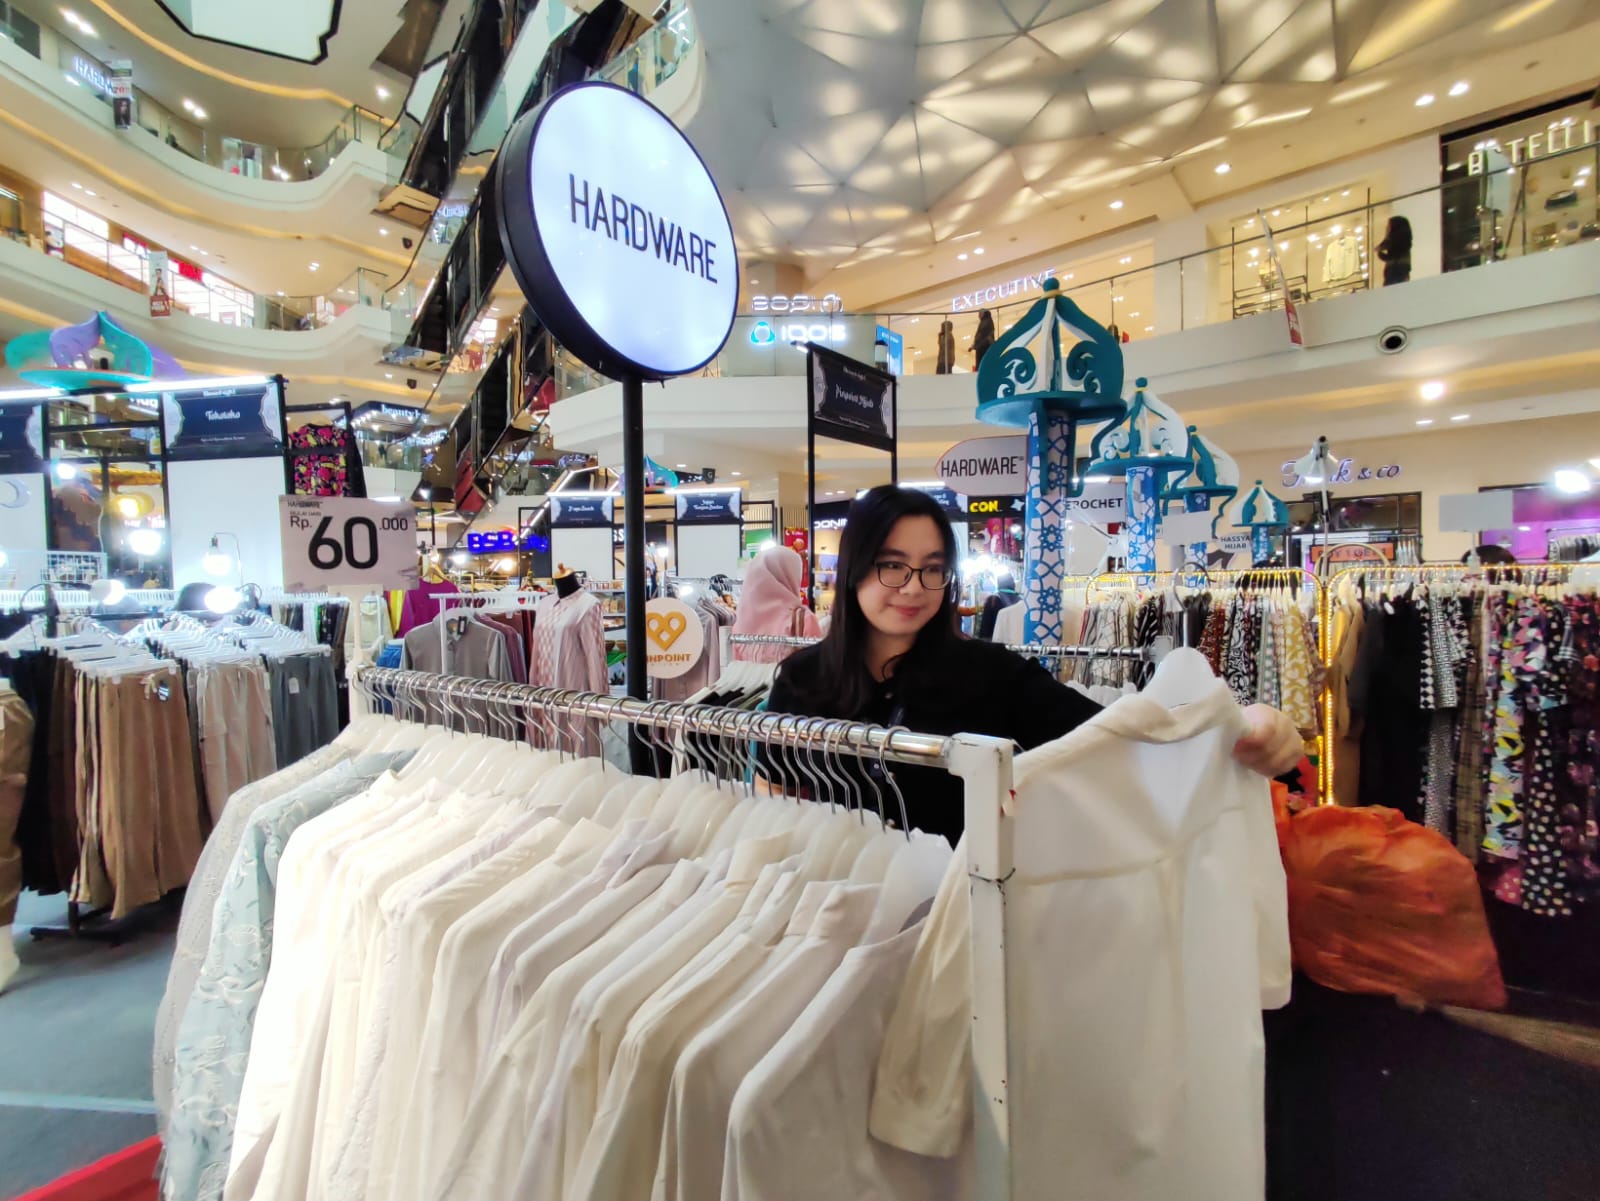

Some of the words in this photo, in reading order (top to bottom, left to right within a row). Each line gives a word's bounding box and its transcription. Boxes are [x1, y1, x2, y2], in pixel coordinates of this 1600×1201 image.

[569, 173, 718, 284] HARDWARE
[941, 456, 1018, 478] HARDWARE
[308, 515, 379, 570] 60
